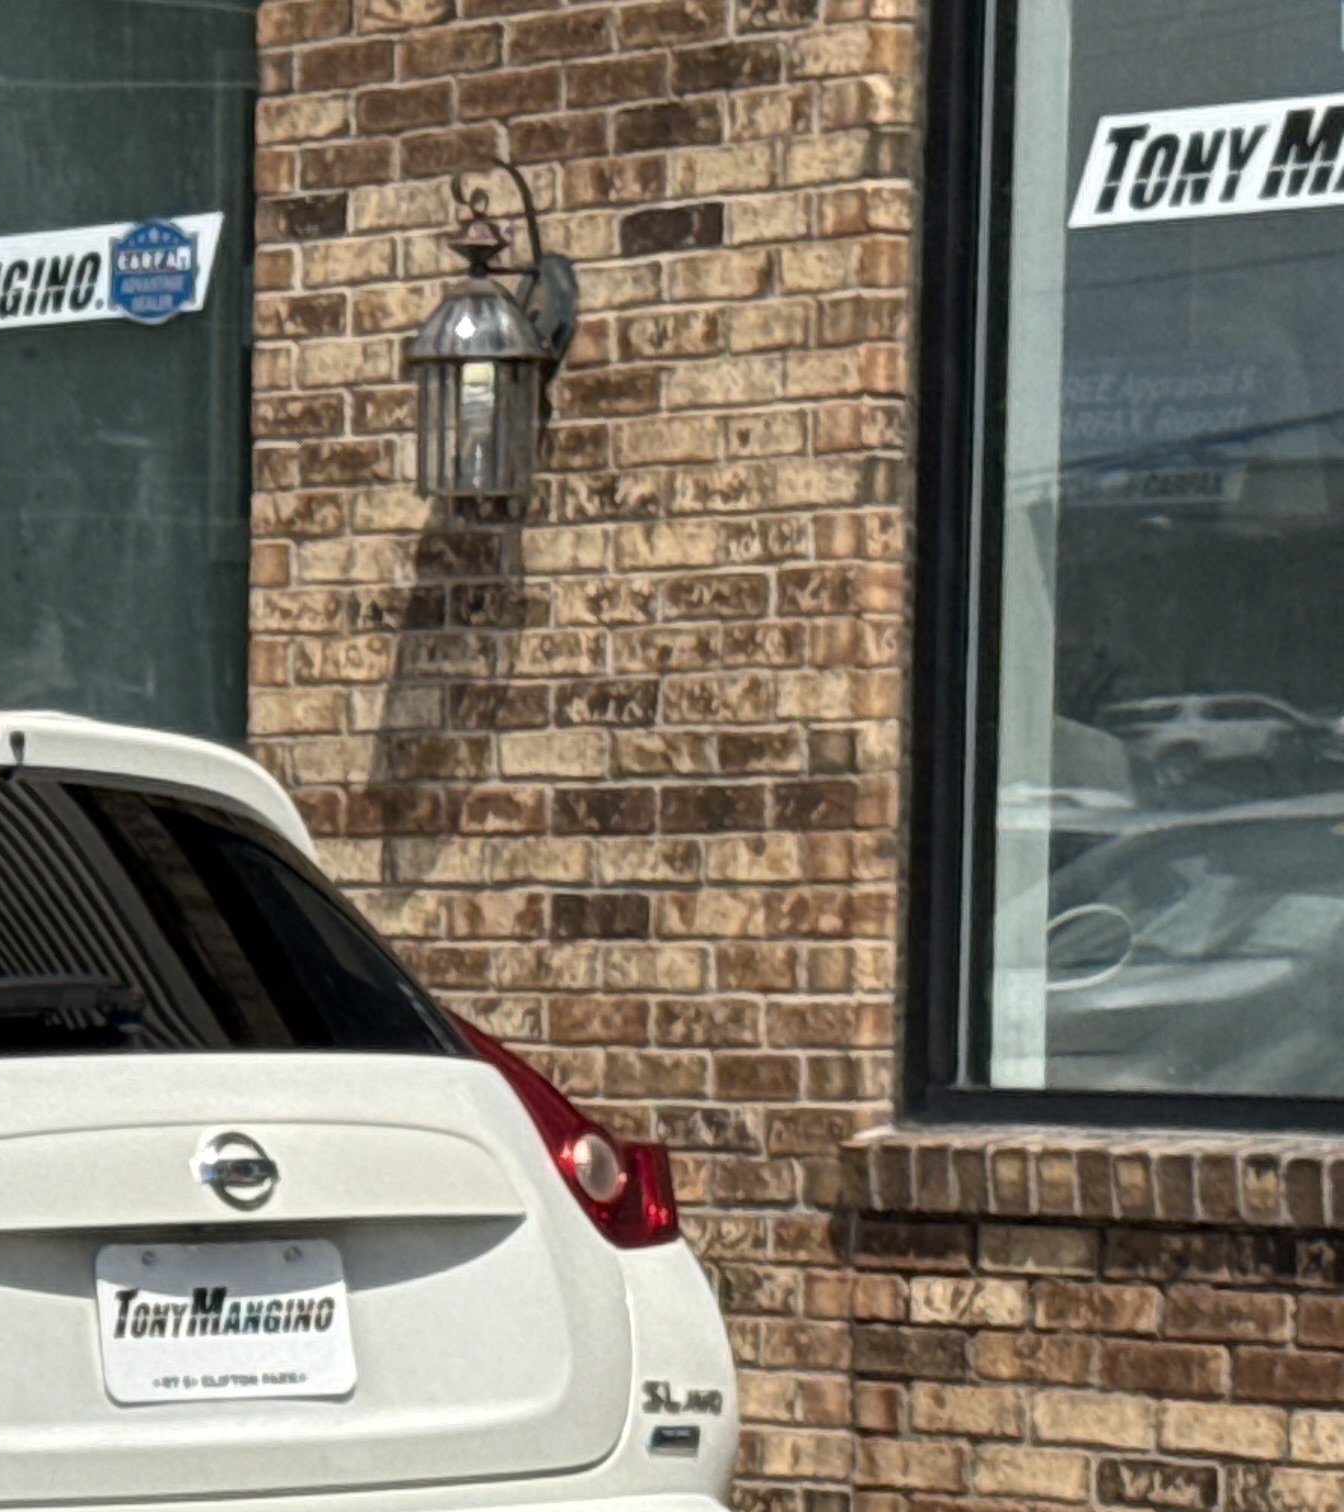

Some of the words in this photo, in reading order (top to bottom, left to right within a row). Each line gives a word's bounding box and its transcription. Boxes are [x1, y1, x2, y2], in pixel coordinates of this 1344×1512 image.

[1094, 123, 1269, 214] TONY
[1257, 104, 1344, 200] M
[114, 1287, 188, 1339] TONY
[187, 1285, 336, 1337] MANGINO
